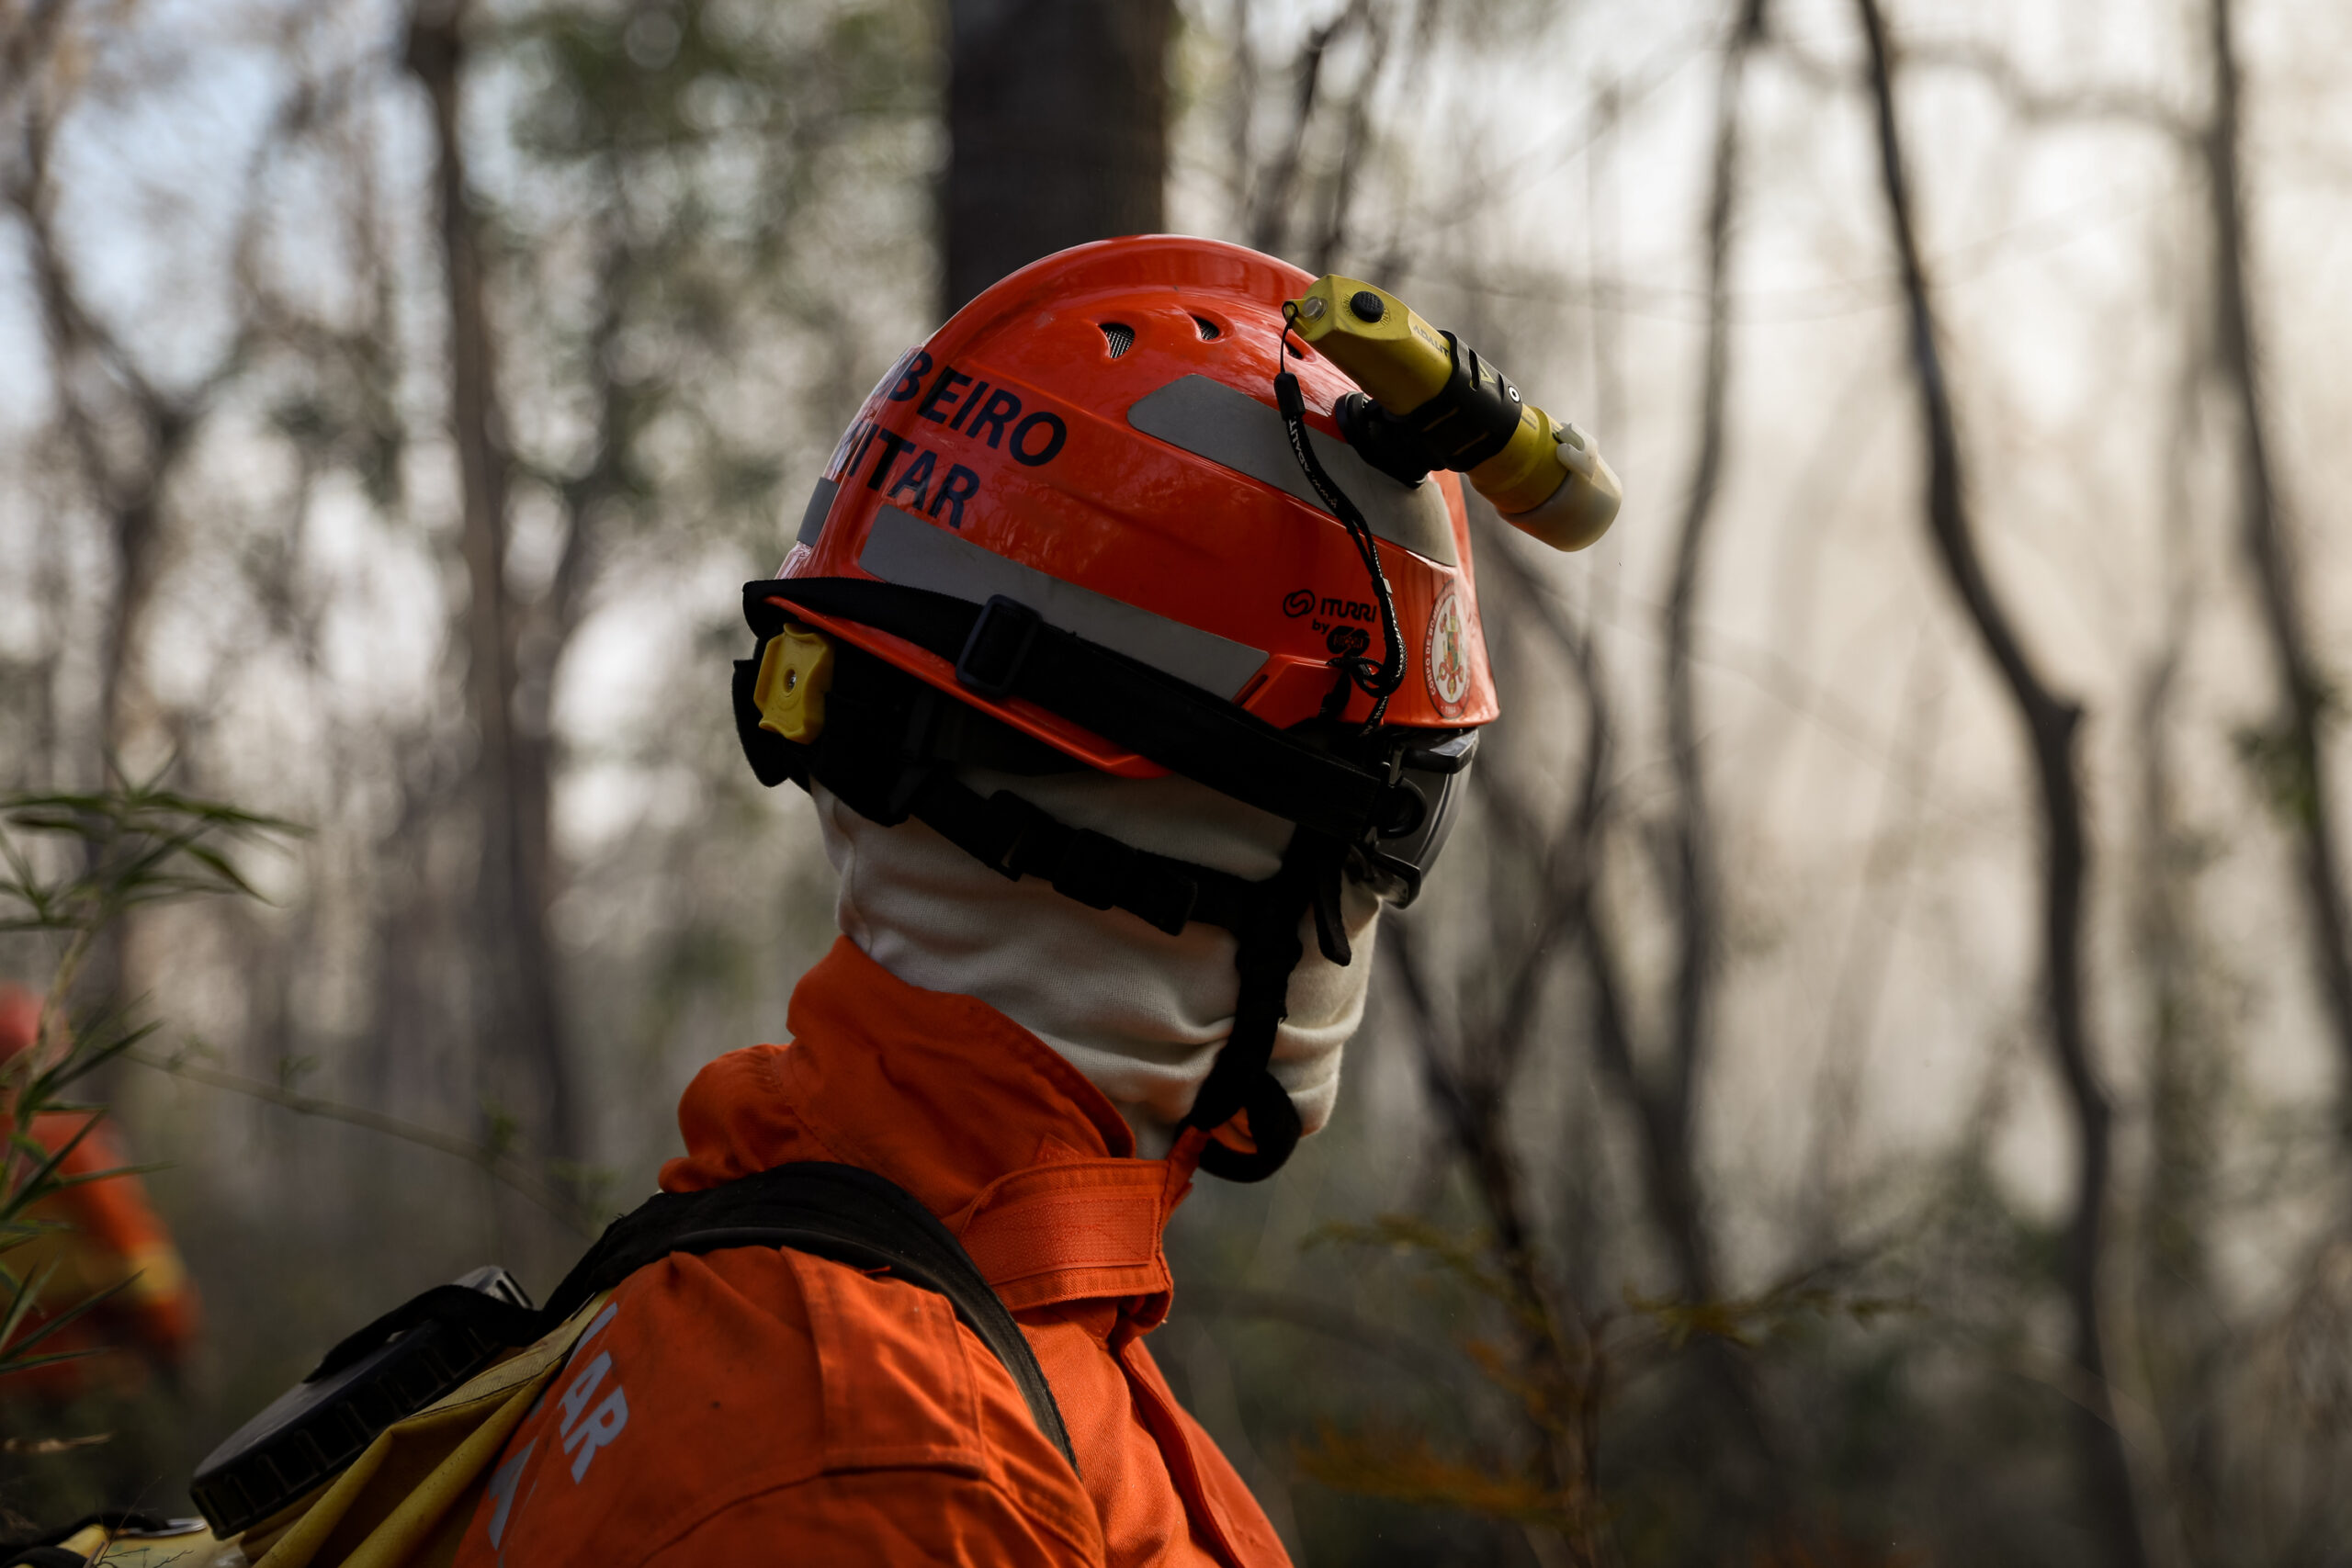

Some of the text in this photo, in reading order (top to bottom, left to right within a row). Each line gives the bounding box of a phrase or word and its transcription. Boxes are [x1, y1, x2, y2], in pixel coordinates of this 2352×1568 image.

[1413, 324, 1450, 356] ADALIT
[1320, 598, 1376, 623] ITURRI
[1312, 619, 1330, 635] by
[1426, 638, 1431, 654] DE
[1425, 658, 1437, 695] CORPO
